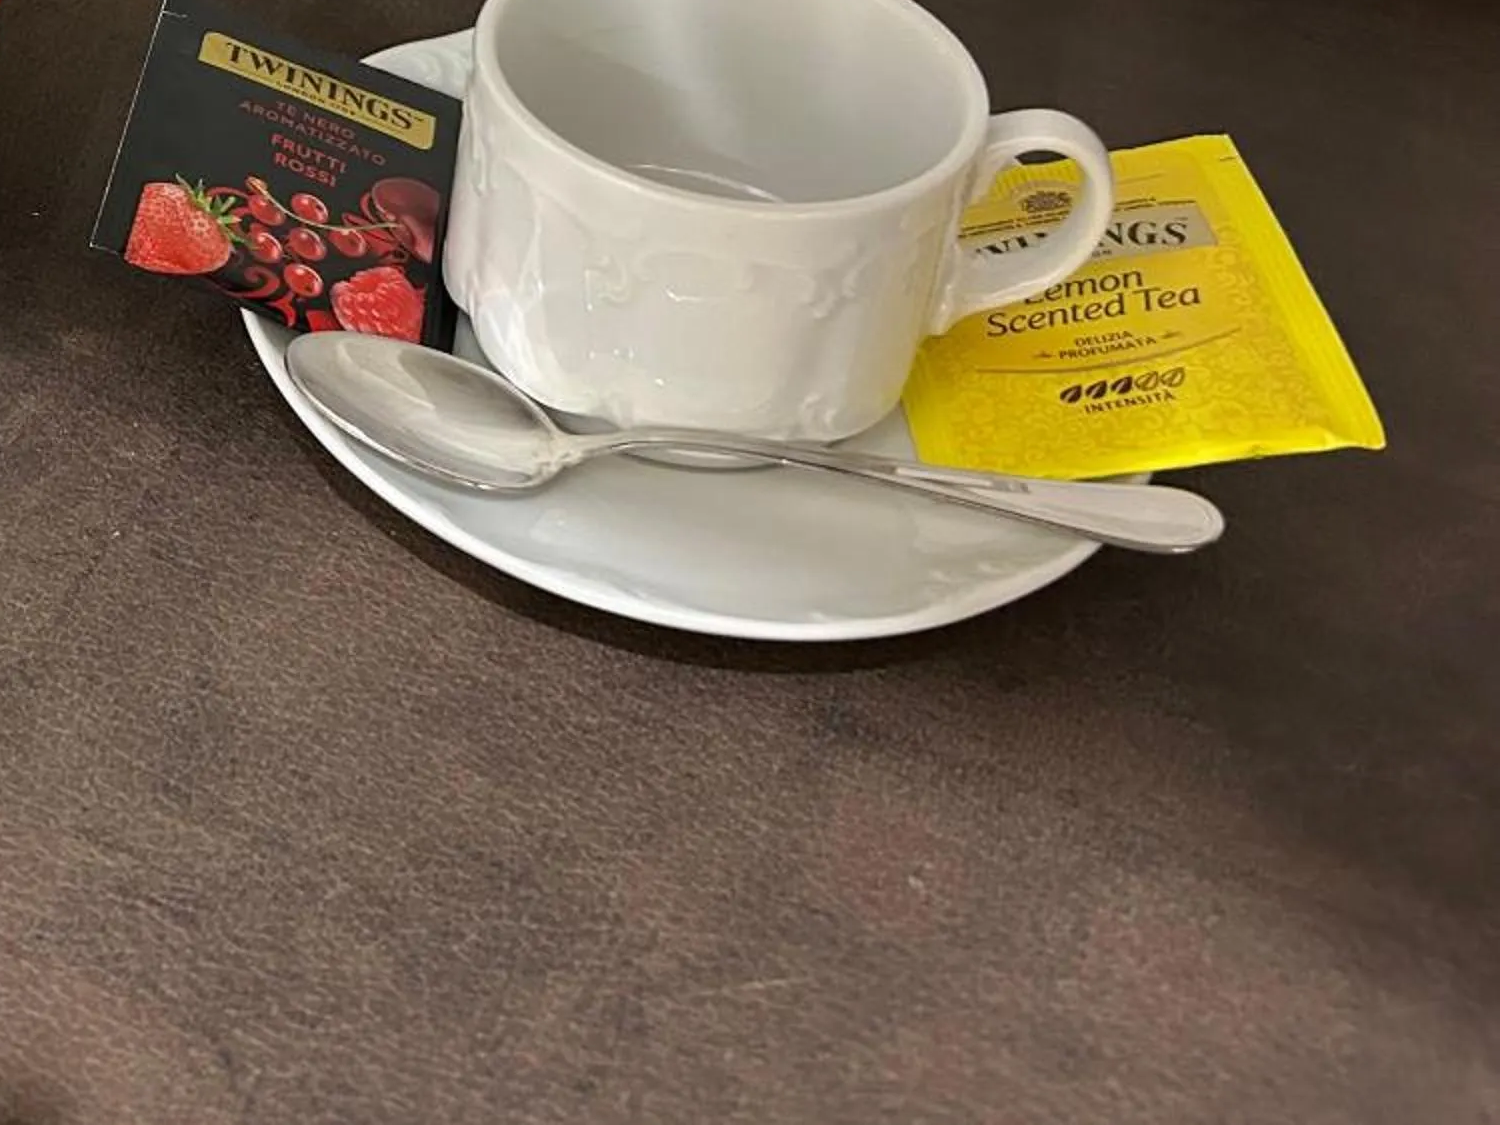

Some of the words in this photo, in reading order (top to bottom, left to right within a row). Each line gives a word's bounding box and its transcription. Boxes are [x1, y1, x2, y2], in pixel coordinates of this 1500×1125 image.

[226, 42, 413, 130] TWININGS
[239, 100, 387, 167] AROMATIZZATO
[304, 111, 357, 141] NERO
[271, 133, 348, 173] FRUTTI
[275, 152, 337, 188] ROSSI
[1024, 269, 1143, 305] emon
[987, 295, 1126, 338] Scented
[1132, 286, 1201, 313] Tea
[1059, 336, 1157, 359] PROFUMATA
[1075, 330, 1133, 347] DELIZIA
